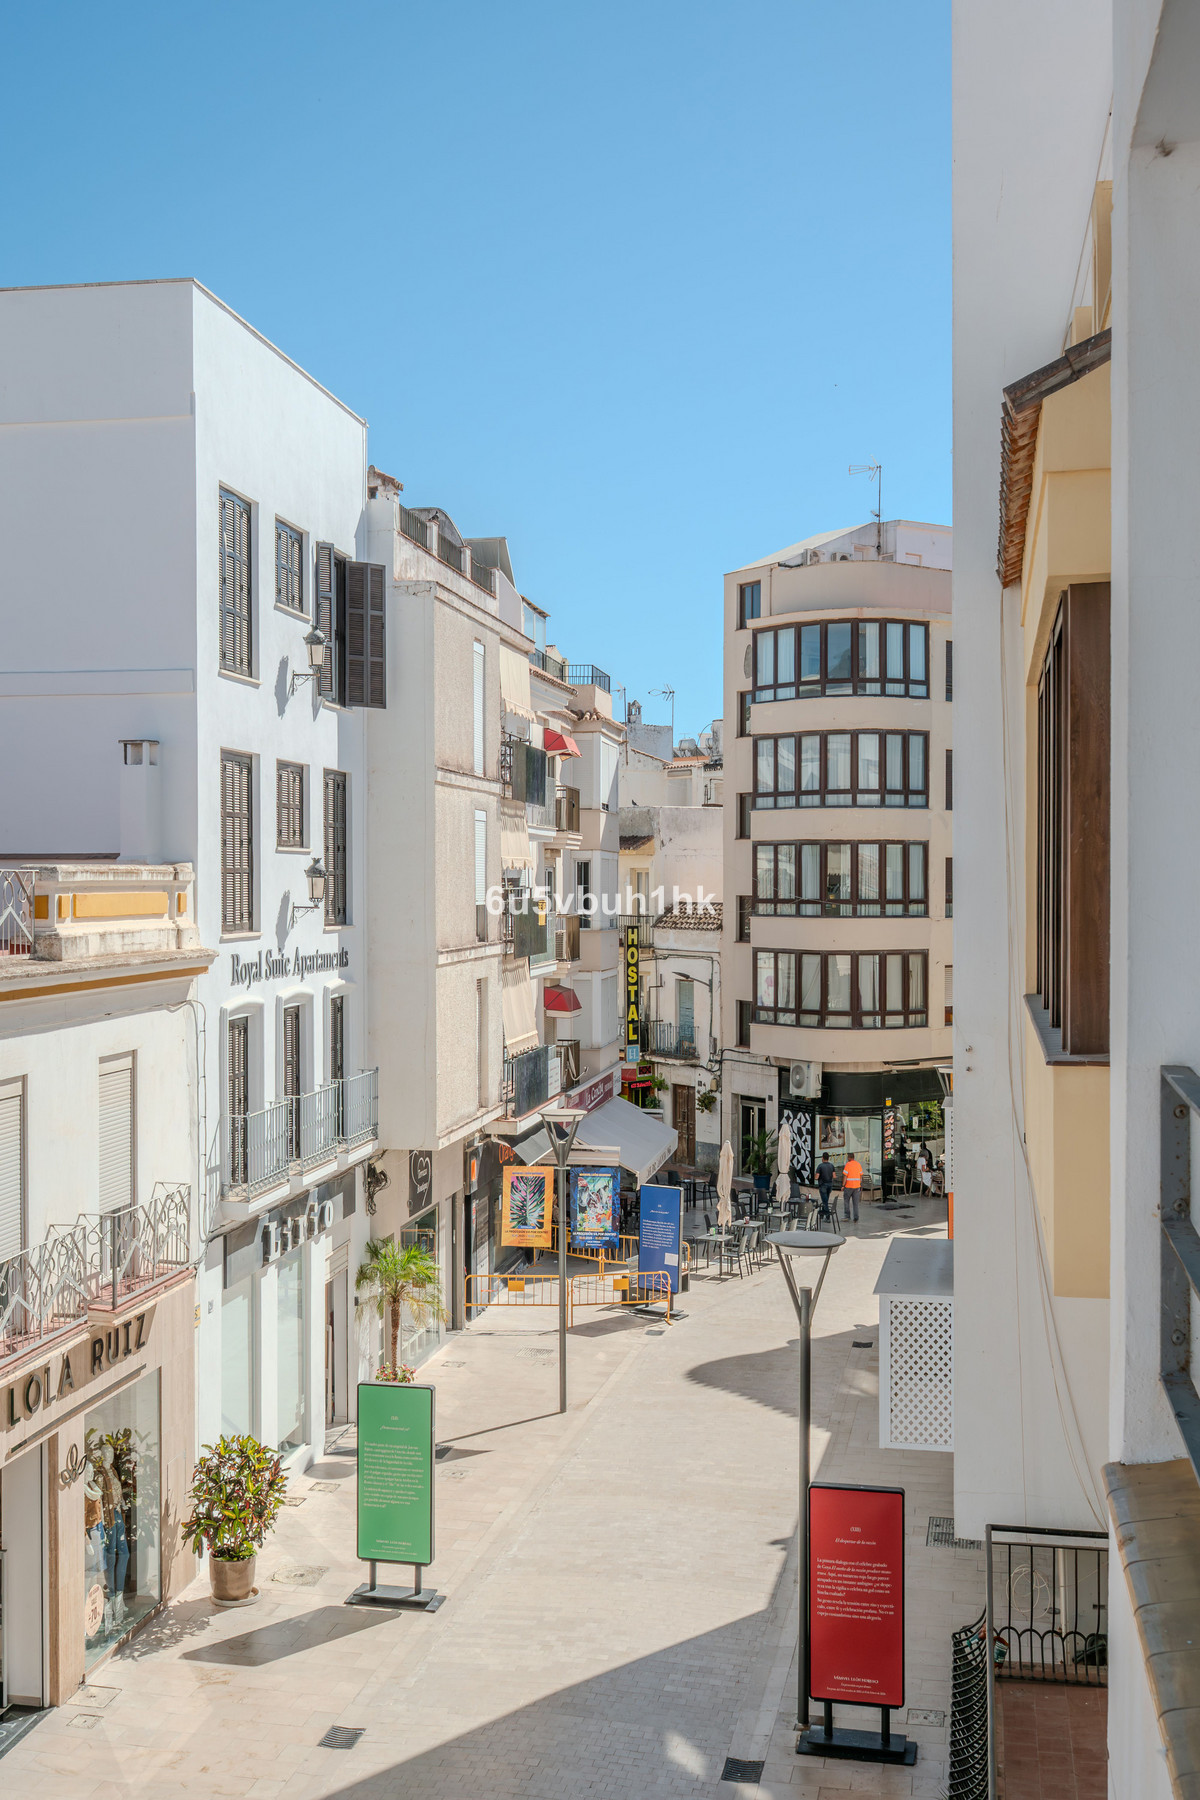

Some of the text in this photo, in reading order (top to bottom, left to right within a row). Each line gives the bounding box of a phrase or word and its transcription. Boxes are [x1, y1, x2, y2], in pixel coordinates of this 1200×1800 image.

[230, 950, 263, 991] Royal
[265, 948, 291, 981] Suite
[627, 929, 639, 1041] HOSTAL
[9, 1313, 146, 1426] LOLA RUIZ
